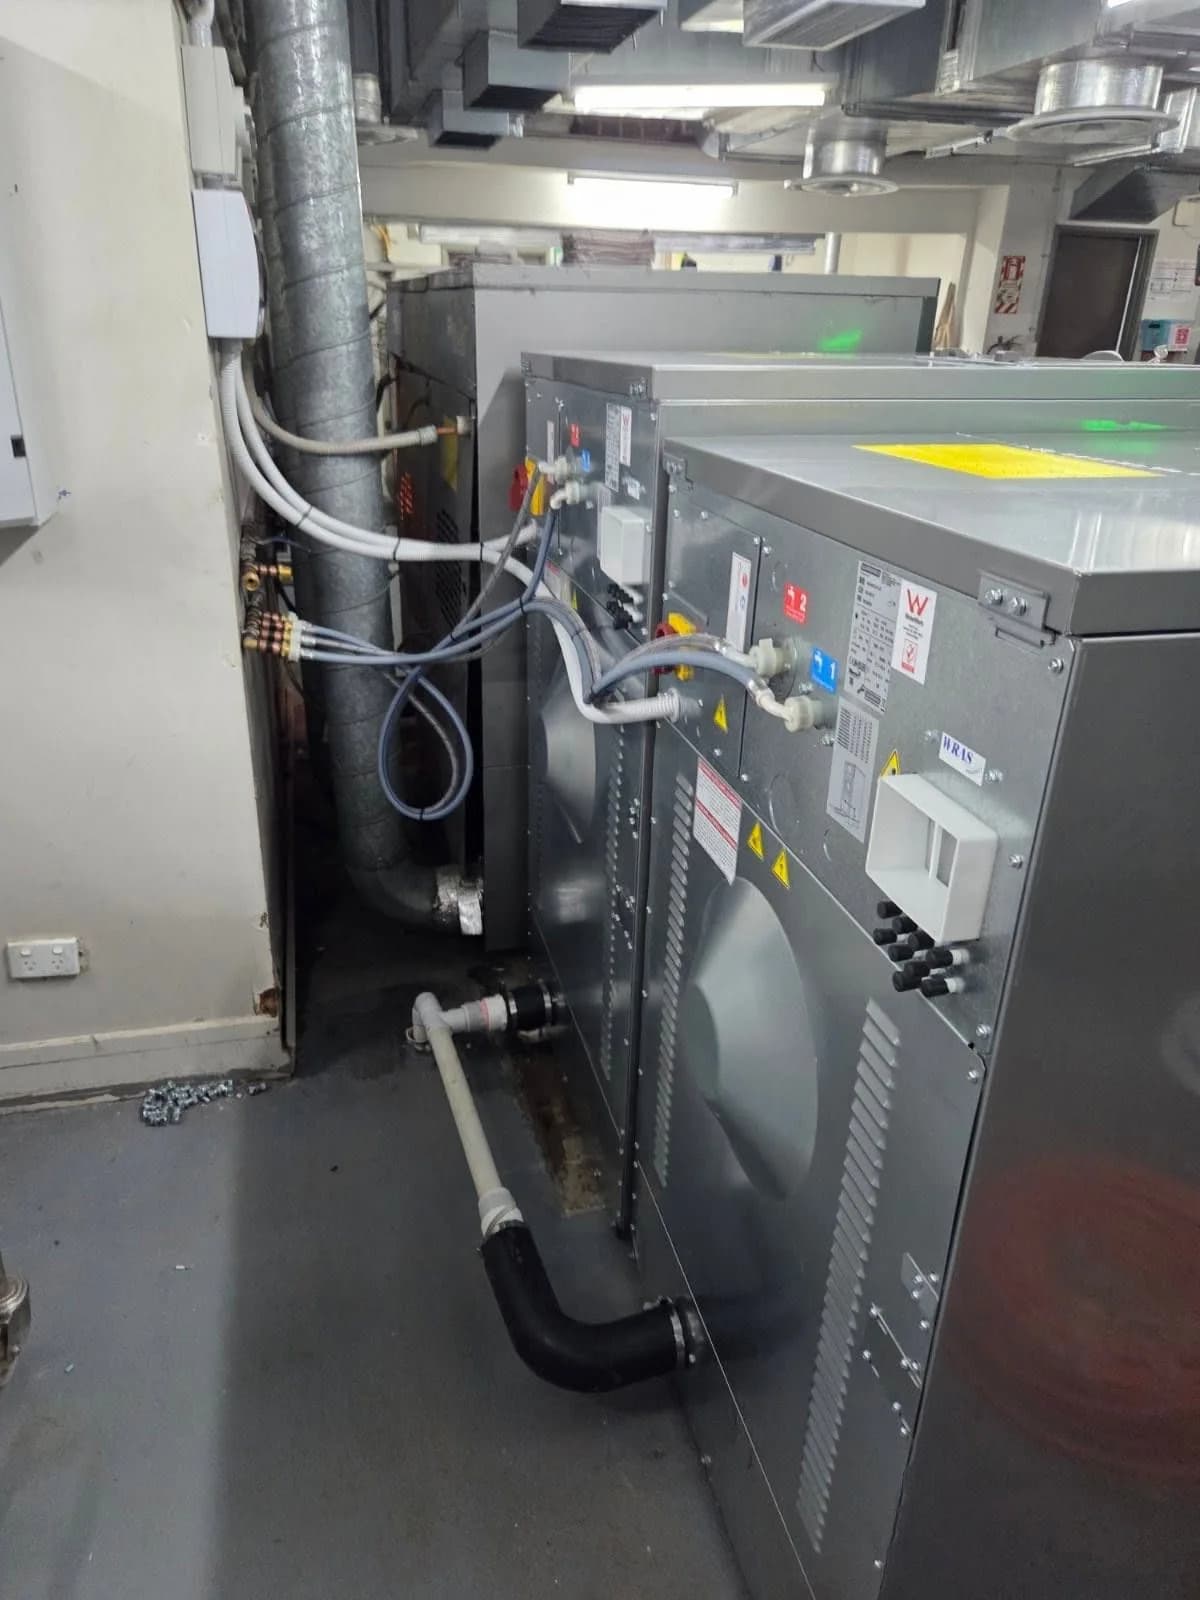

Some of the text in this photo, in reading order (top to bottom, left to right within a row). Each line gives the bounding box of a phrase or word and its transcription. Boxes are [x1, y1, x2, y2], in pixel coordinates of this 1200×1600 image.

[799, 593, 807, 612] 2
[907, 588, 929, 616] W
[943, 736, 974, 764] WRAS
